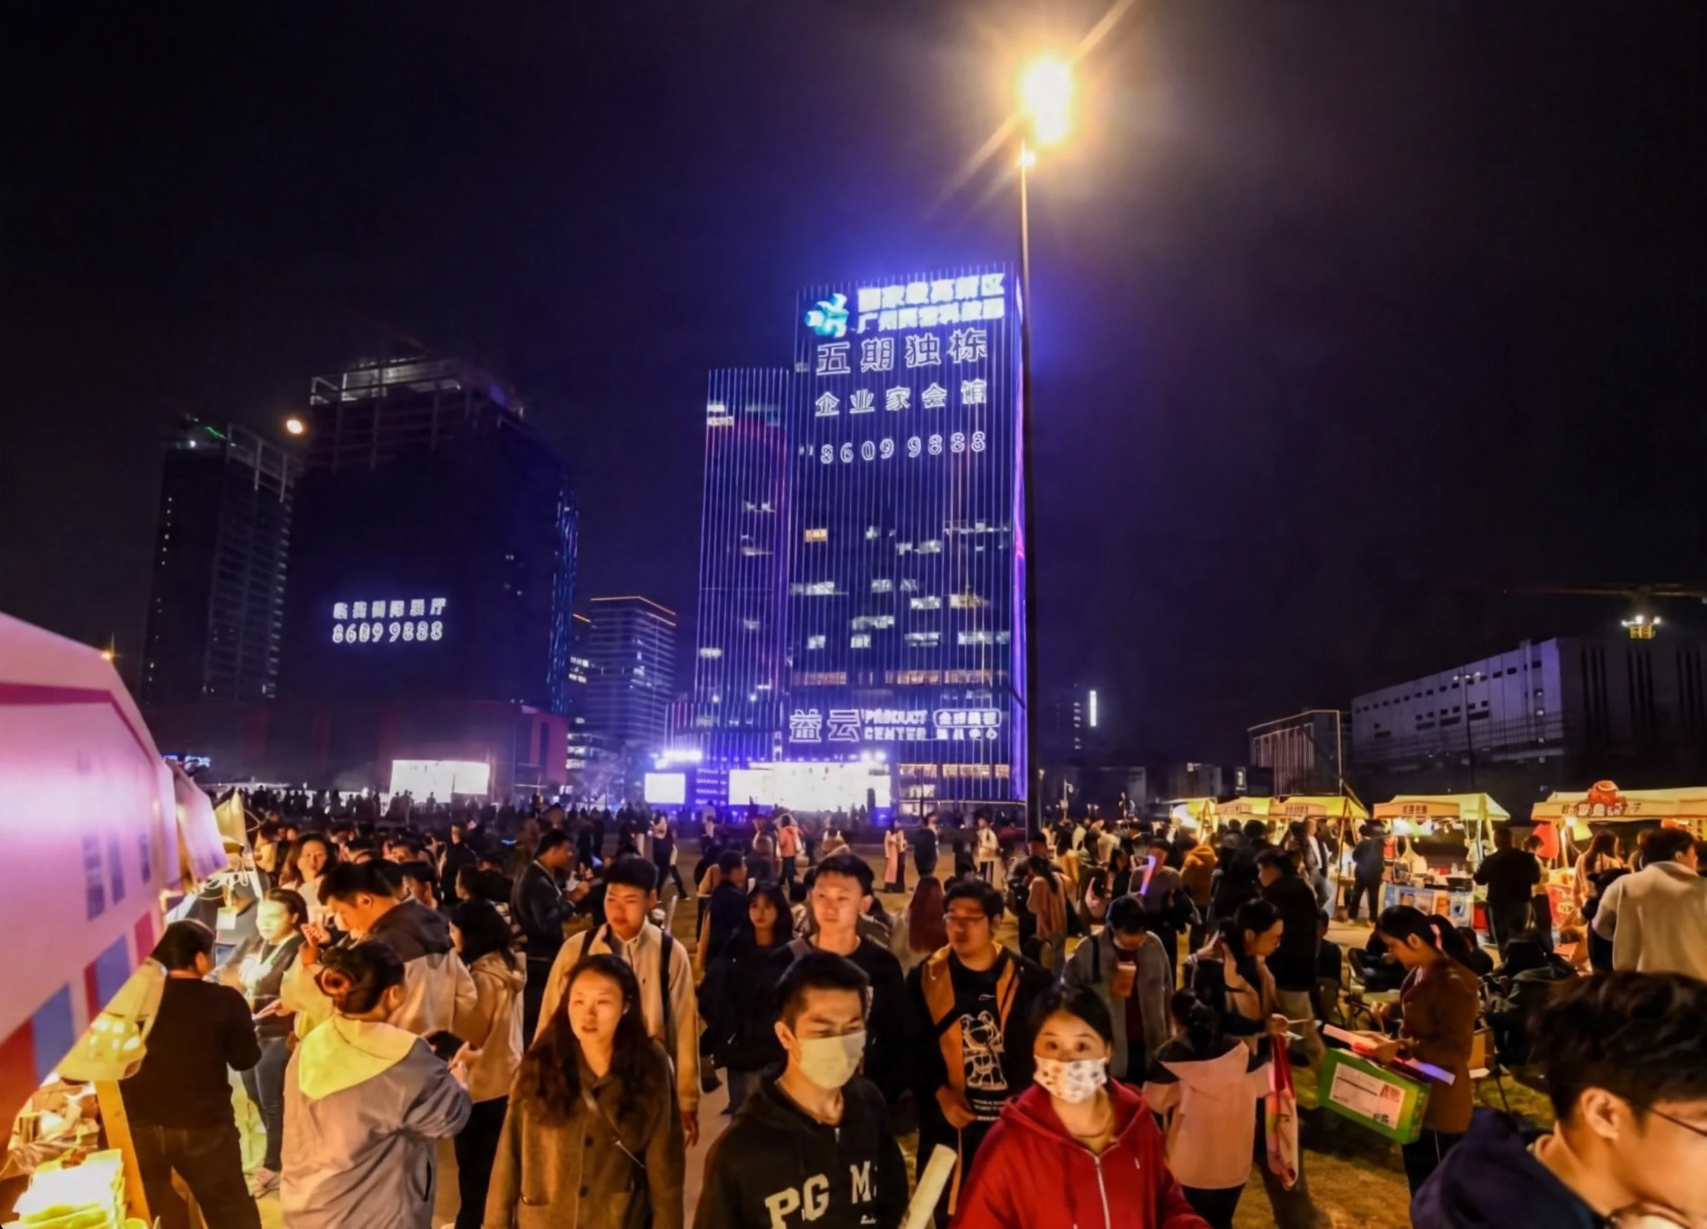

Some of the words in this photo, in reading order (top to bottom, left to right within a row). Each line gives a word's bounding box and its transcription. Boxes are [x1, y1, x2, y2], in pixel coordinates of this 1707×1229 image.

[816, 327, 988, 376] 五期独栋
[819, 437, 895, 465] 8609
[907, 431, 987, 458] 9888
[333, 622, 384, 644] 8609
[390, 621, 442, 643] 9888
[788, 708, 861, 743] 益云
